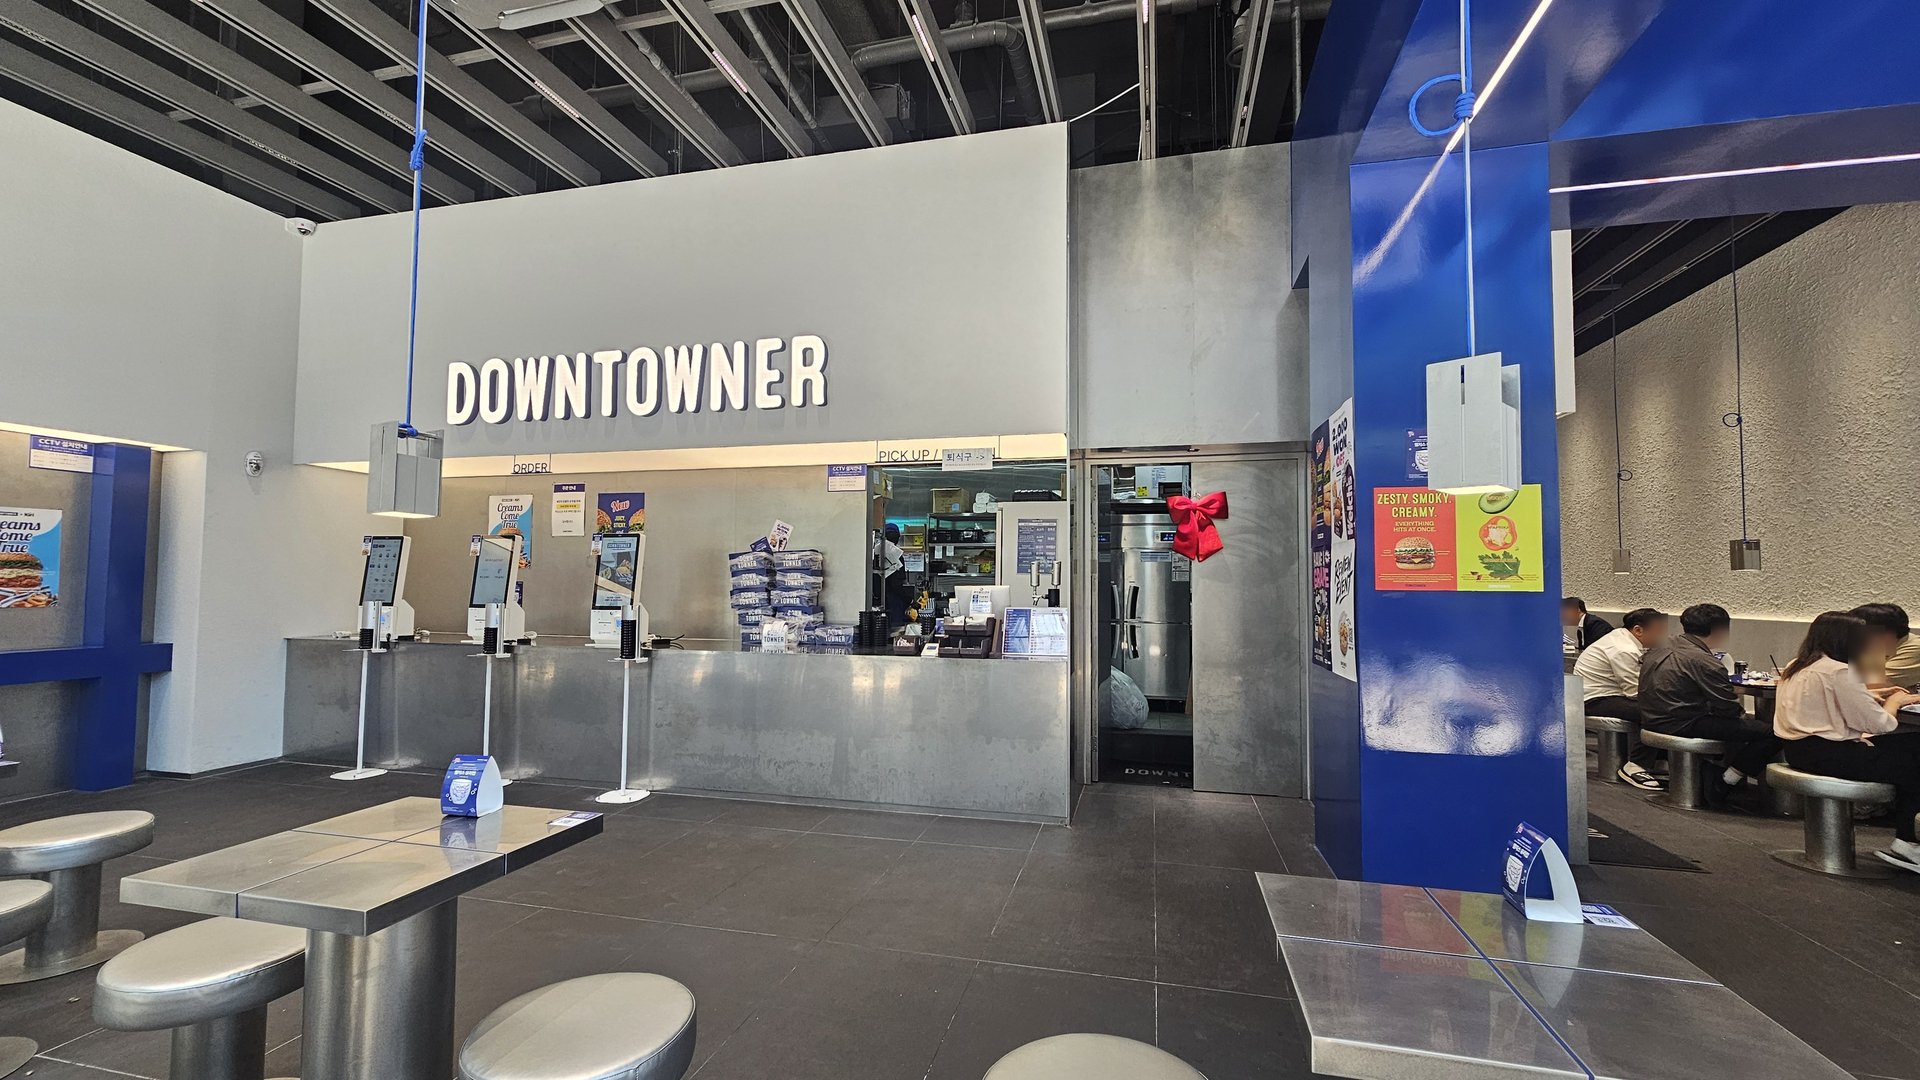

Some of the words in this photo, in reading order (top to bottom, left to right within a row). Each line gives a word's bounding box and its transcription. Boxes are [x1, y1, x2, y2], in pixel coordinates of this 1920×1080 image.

[446, 335, 829, 426] DOWNTOWNER
[38, 438, 61, 446] CCTV
[879, 450, 909, 462] PICK
[911, 449, 930, 461] UP
[947, 452, 973, 462] 퇴식구
[513, 462, 548, 474] ORDER
[1377, 493, 1411, 505] ZESTY.
[1412, 492, 1452, 504] SMOKY.
[497, 503, 524, 513] Creams
[1391, 506, 1438, 518] CREAMY.
[500, 511, 520, 521] Come
[0, 520, 41, 531] eams
[501, 519, 518, 529] True
[0, 531, 33, 541] ome
[825, 635, 846, 643] TOWNER
[1124, 767, 1192, 778] DOWNT
